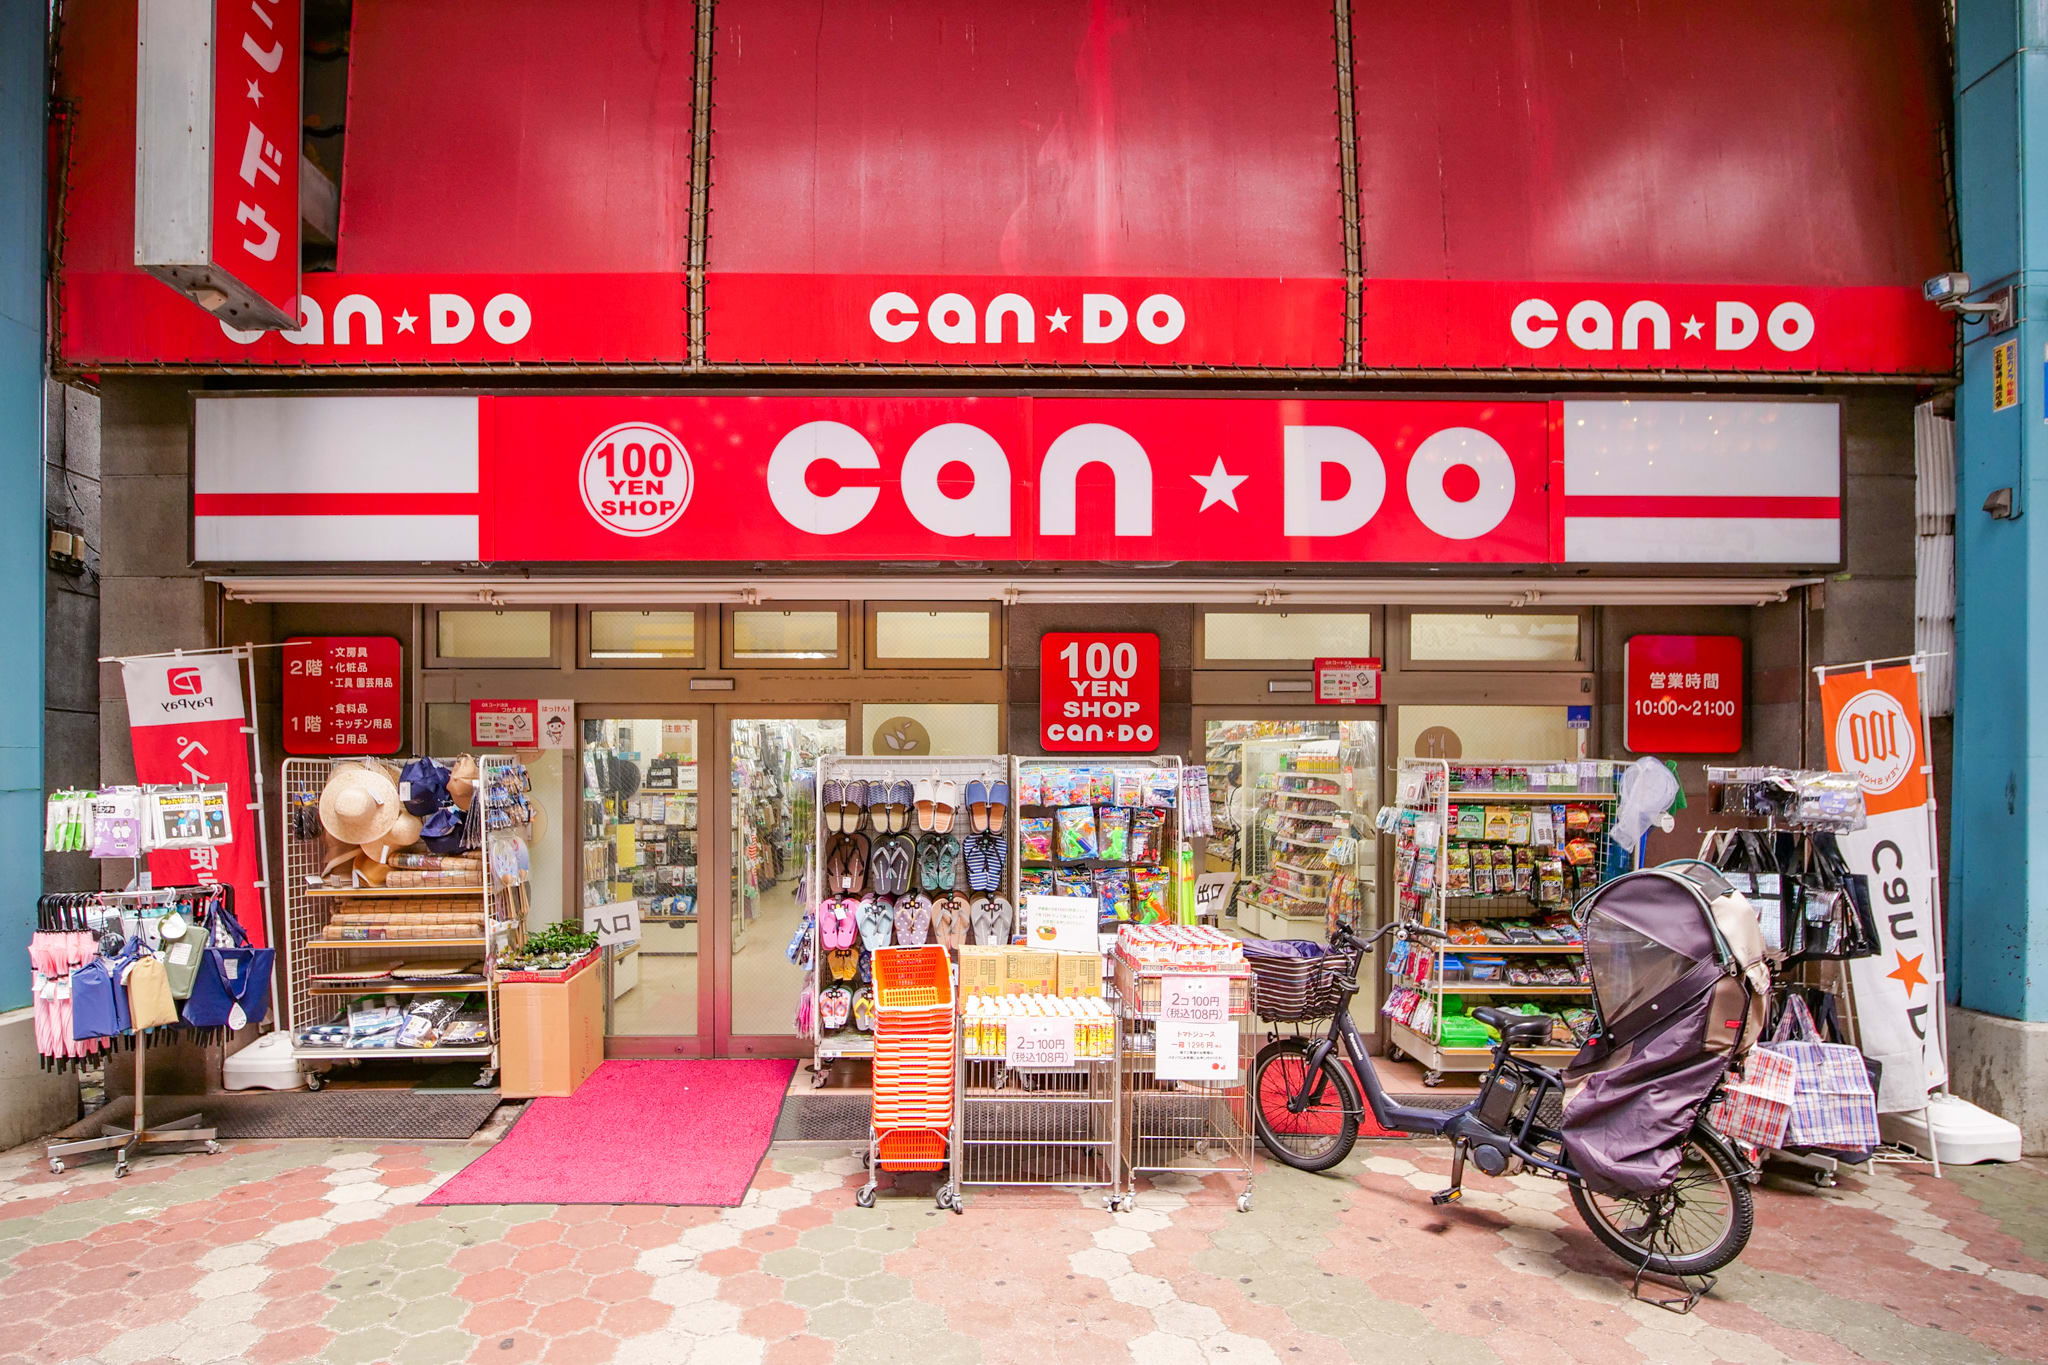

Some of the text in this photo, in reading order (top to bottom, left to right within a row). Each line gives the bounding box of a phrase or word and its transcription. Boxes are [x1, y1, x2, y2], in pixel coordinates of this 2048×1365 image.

[597, 442, 673, 478] 100
[608, 480, 664, 495] YEN
[600, 500, 676, 516] SHOP
[289, 659, 323, 677] 2階
[1060, 641, 1138, 679] 100
[1070, 680, 1129, 697] YEN
[1649, 672, 1720, 690] 営業時間
[1062, 701, 1141, 718] SHOP
[290, 715, 322, 733] 1階
[1196, 883, 1225, 905] 出口
[593, 913, 632, 936] 入口
